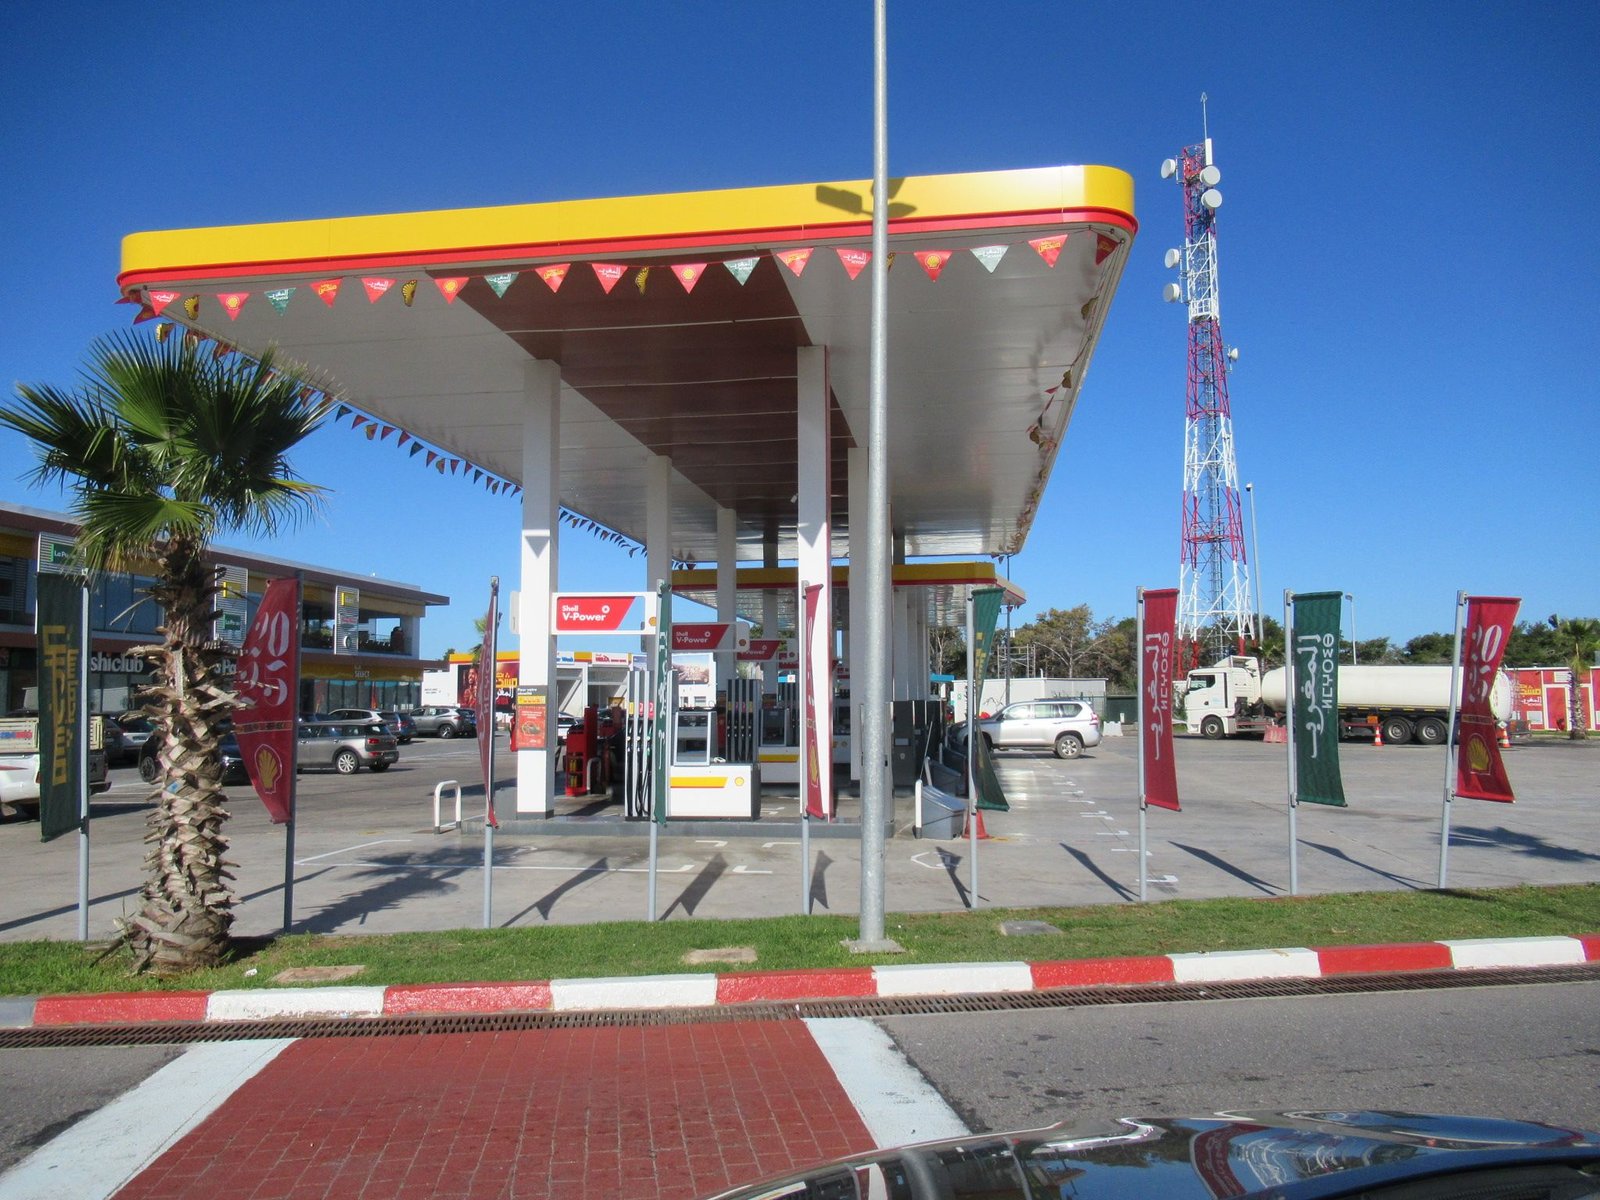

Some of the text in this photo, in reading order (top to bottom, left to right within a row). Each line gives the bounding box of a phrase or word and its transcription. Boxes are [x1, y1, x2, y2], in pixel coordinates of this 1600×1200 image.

[562, 612, 606, 621] V-Power
[91, 655, 143, 673] shiclub
[1145, 632, 1164, 761] المغرب
[1297, 633, 1325, 759] المغرب
